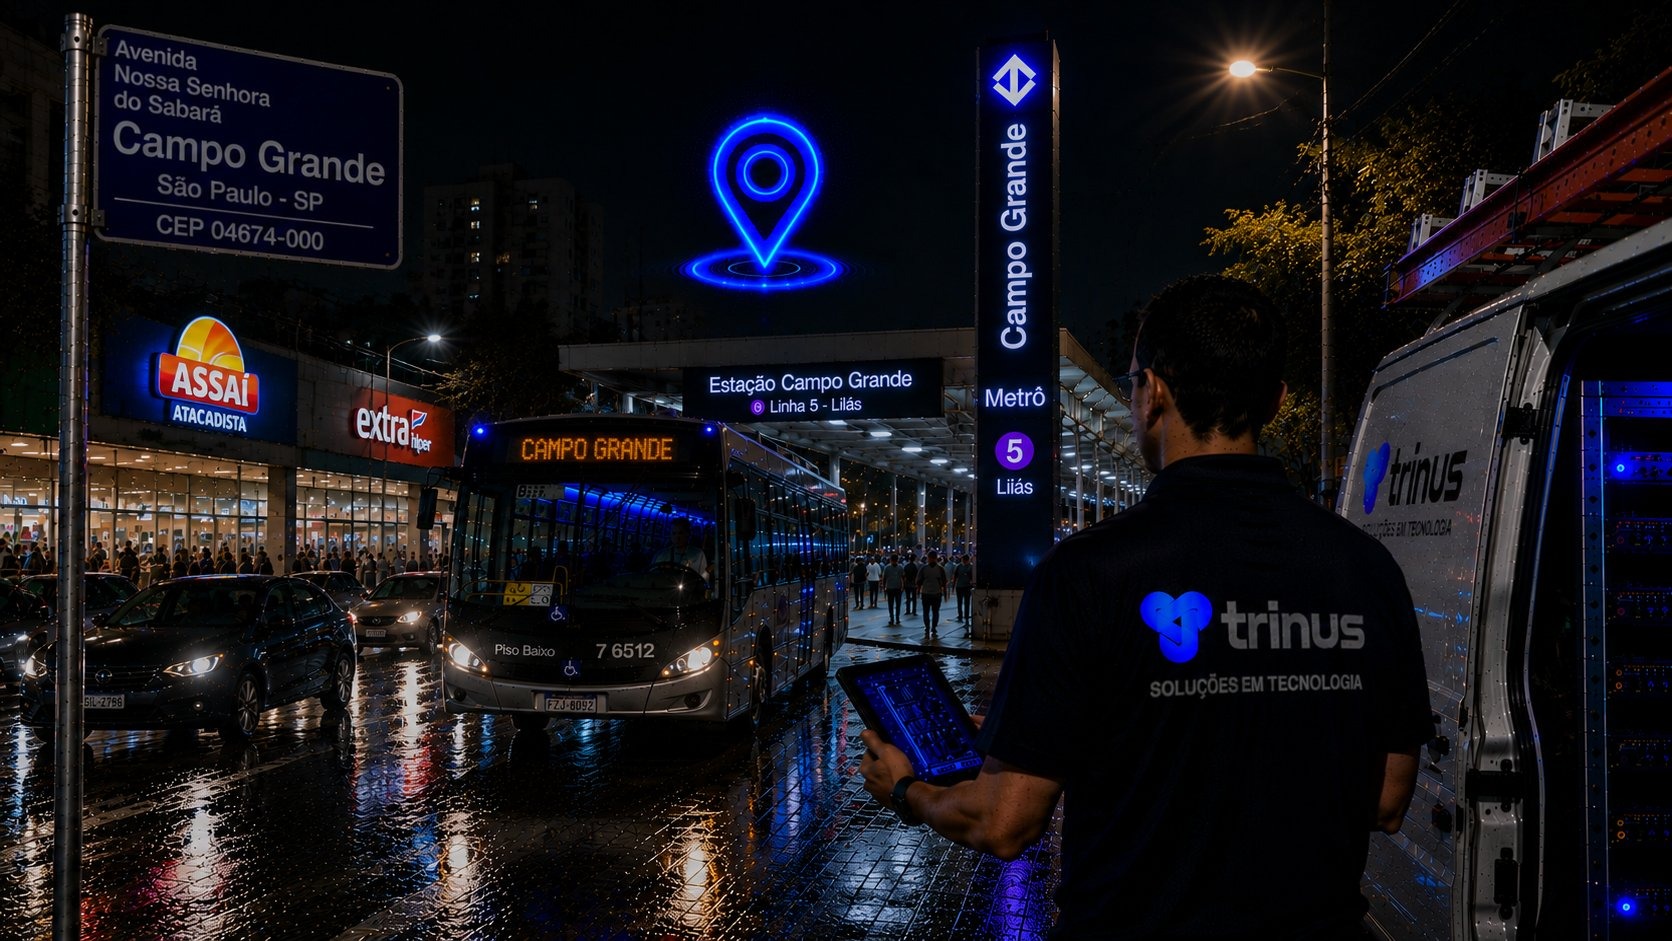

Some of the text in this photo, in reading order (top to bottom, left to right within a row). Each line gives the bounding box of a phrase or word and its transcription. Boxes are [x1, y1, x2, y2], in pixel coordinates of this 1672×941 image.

[114, 39, 197, 70] Avenida
[114, 64, 271, 107] Nossa Senhora
[113, 90, 222, 124] do Sabará
[113, 120, 385, 186] Campo Grande
[157, 173, 202, 199] São
[210, 180, 272, 207] Paulo
[293, 190, 324, 212] SP
[156, 214, 324, 251] CEP 04674-000
[1000, 123, 1032, 350] Campo Grande
[171, 362, 250, 407] ASSAÍ
[709, 370, 912, 396] Estação Campo Grande
[985, 386, 1046, 407] Metrô
[172, 404, 247, 432] ATACADISTA
[770, 399, 806, 413] Linha
[809, 399, 819, 412] 5
[831, 397, 862, 411] Lilás
[356, 405, 410, 446] extra
[521, 437, 673, 460] CAMPO GRANDE
[1006, 438, 1023, 464] 5
[1389, 442, 1467, 506] trinus
[1221, 600, 1365, 650] trinus
[494, 643, 556, 657] Piso Baixo
[596, 642, 655, 659] 7 6512
[1150, 673, 1363, 700] SOLUÇÕES EM TECNOLOGIA
